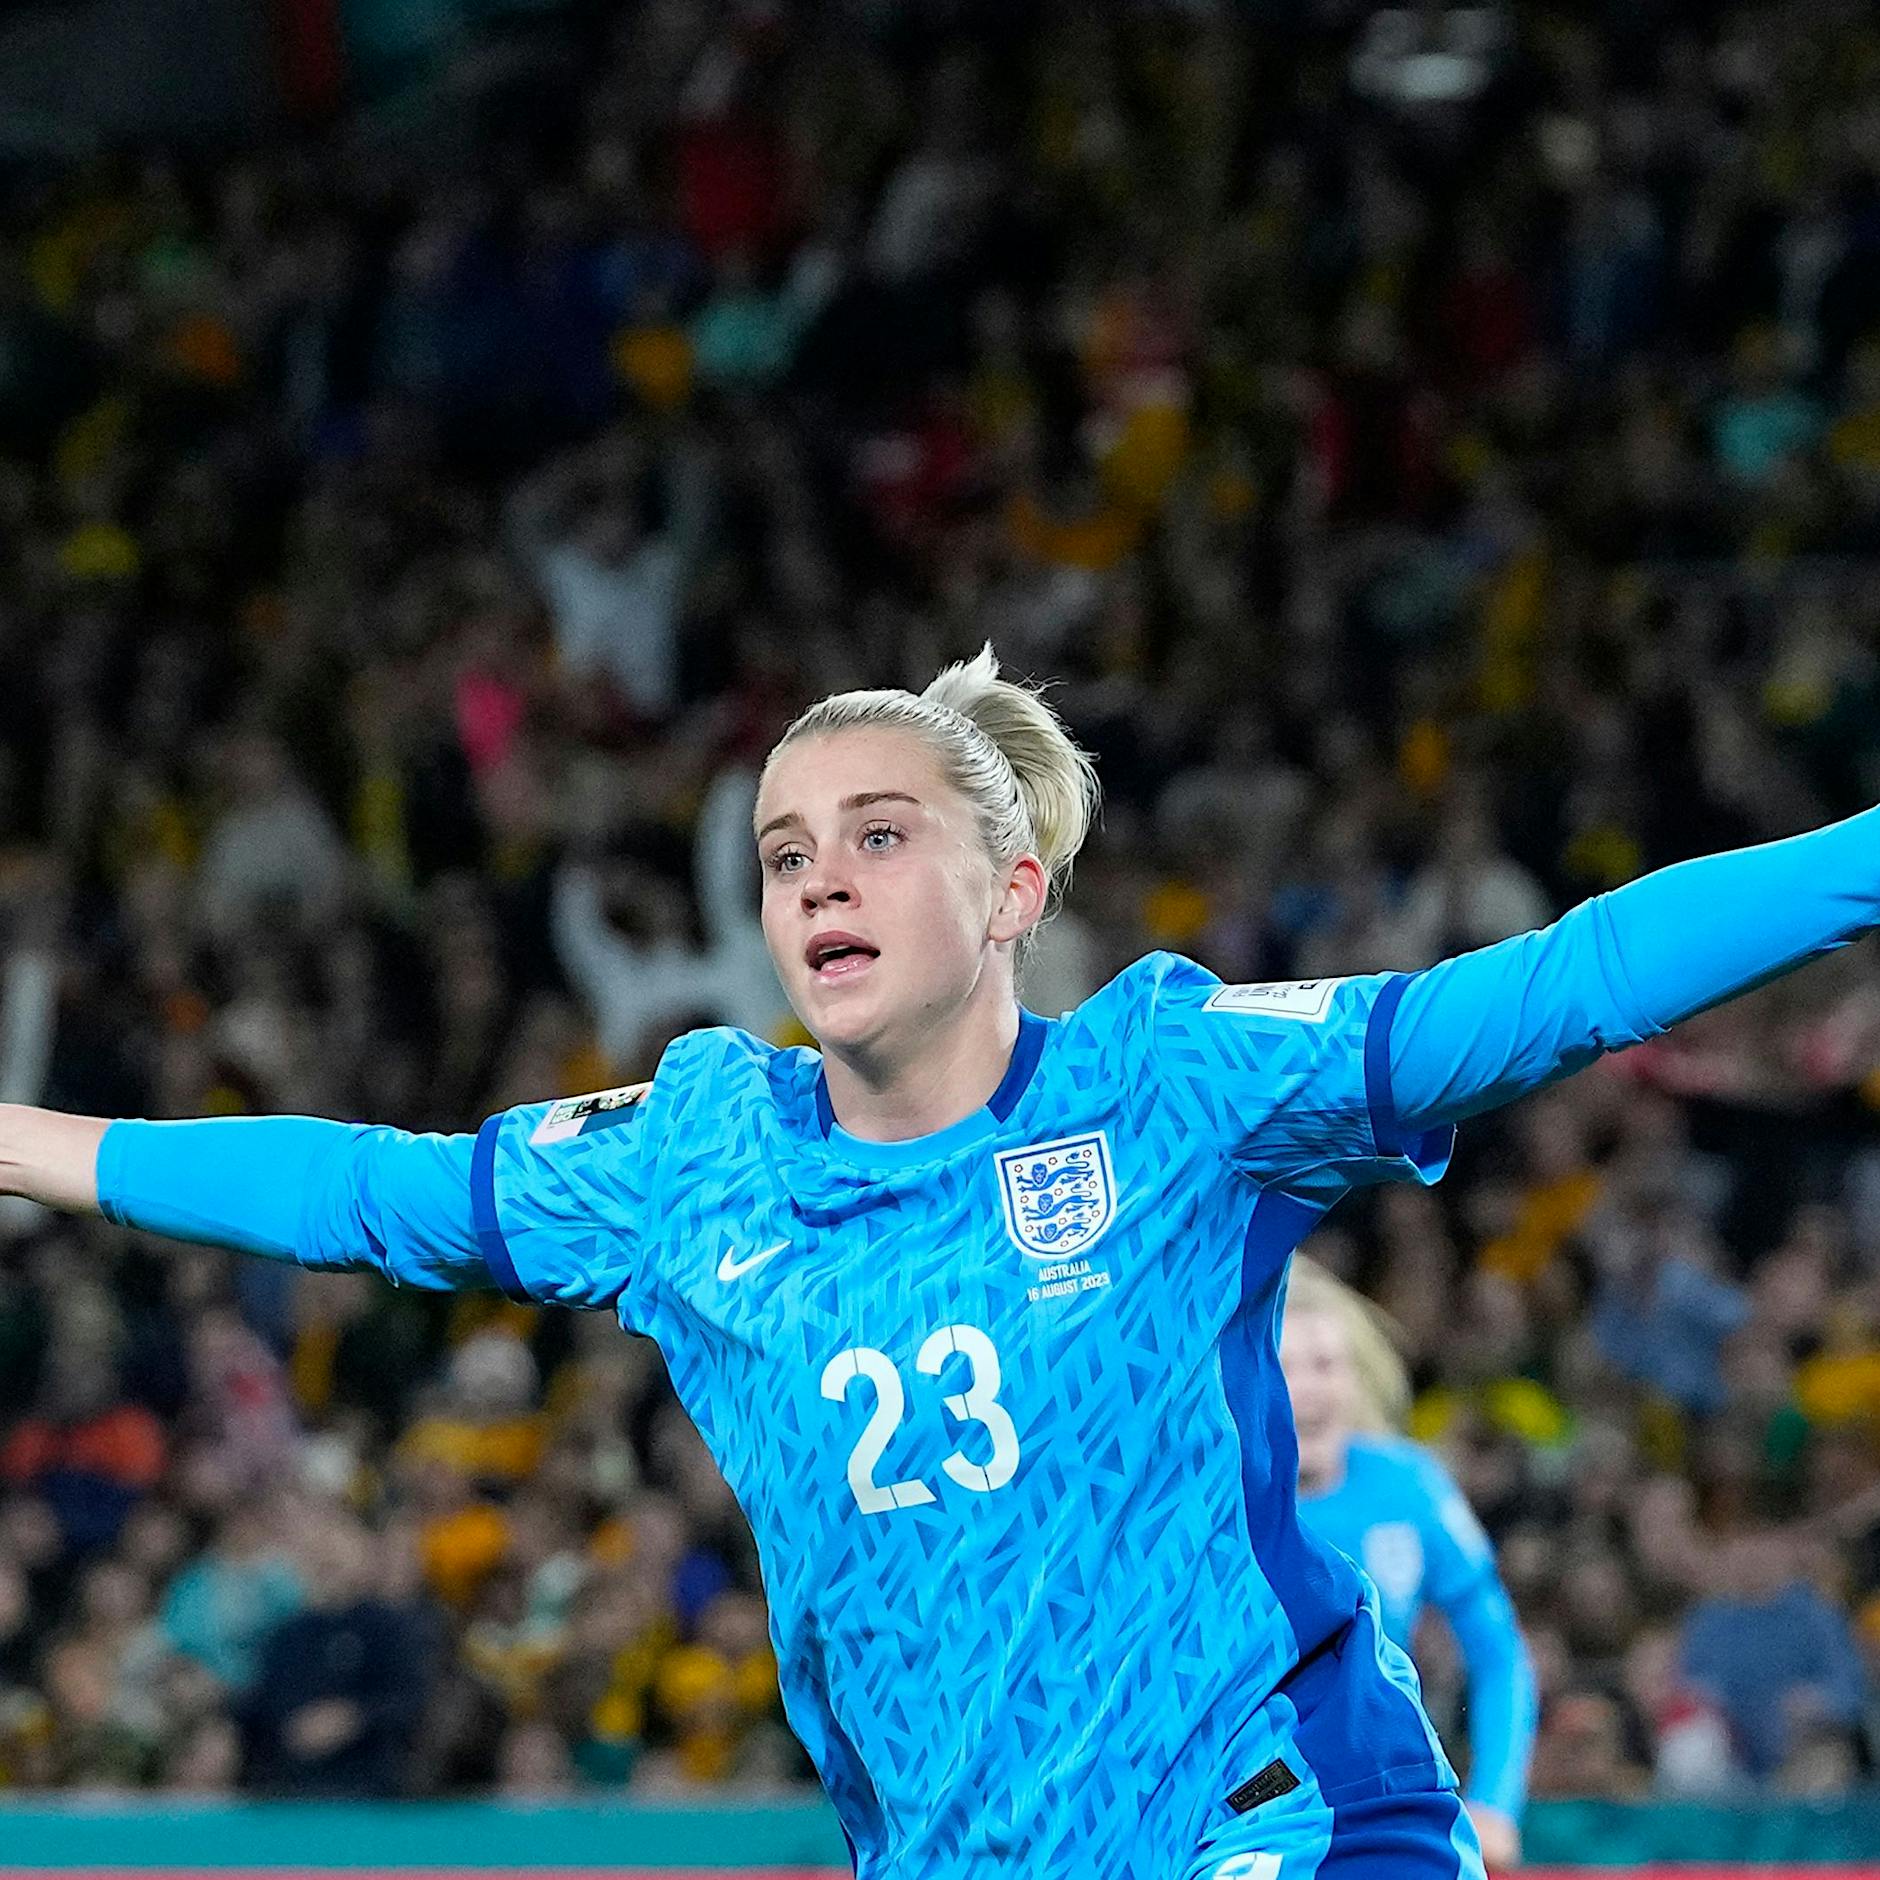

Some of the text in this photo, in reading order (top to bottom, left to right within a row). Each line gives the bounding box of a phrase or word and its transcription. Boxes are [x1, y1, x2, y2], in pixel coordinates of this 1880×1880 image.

[1039, 1259, 1092, 1282] AUSTRALIA
[1027, 1272, 1110, 1302] 16 AUGUST 2023
[820, 1324, 1020, 1515] 23
